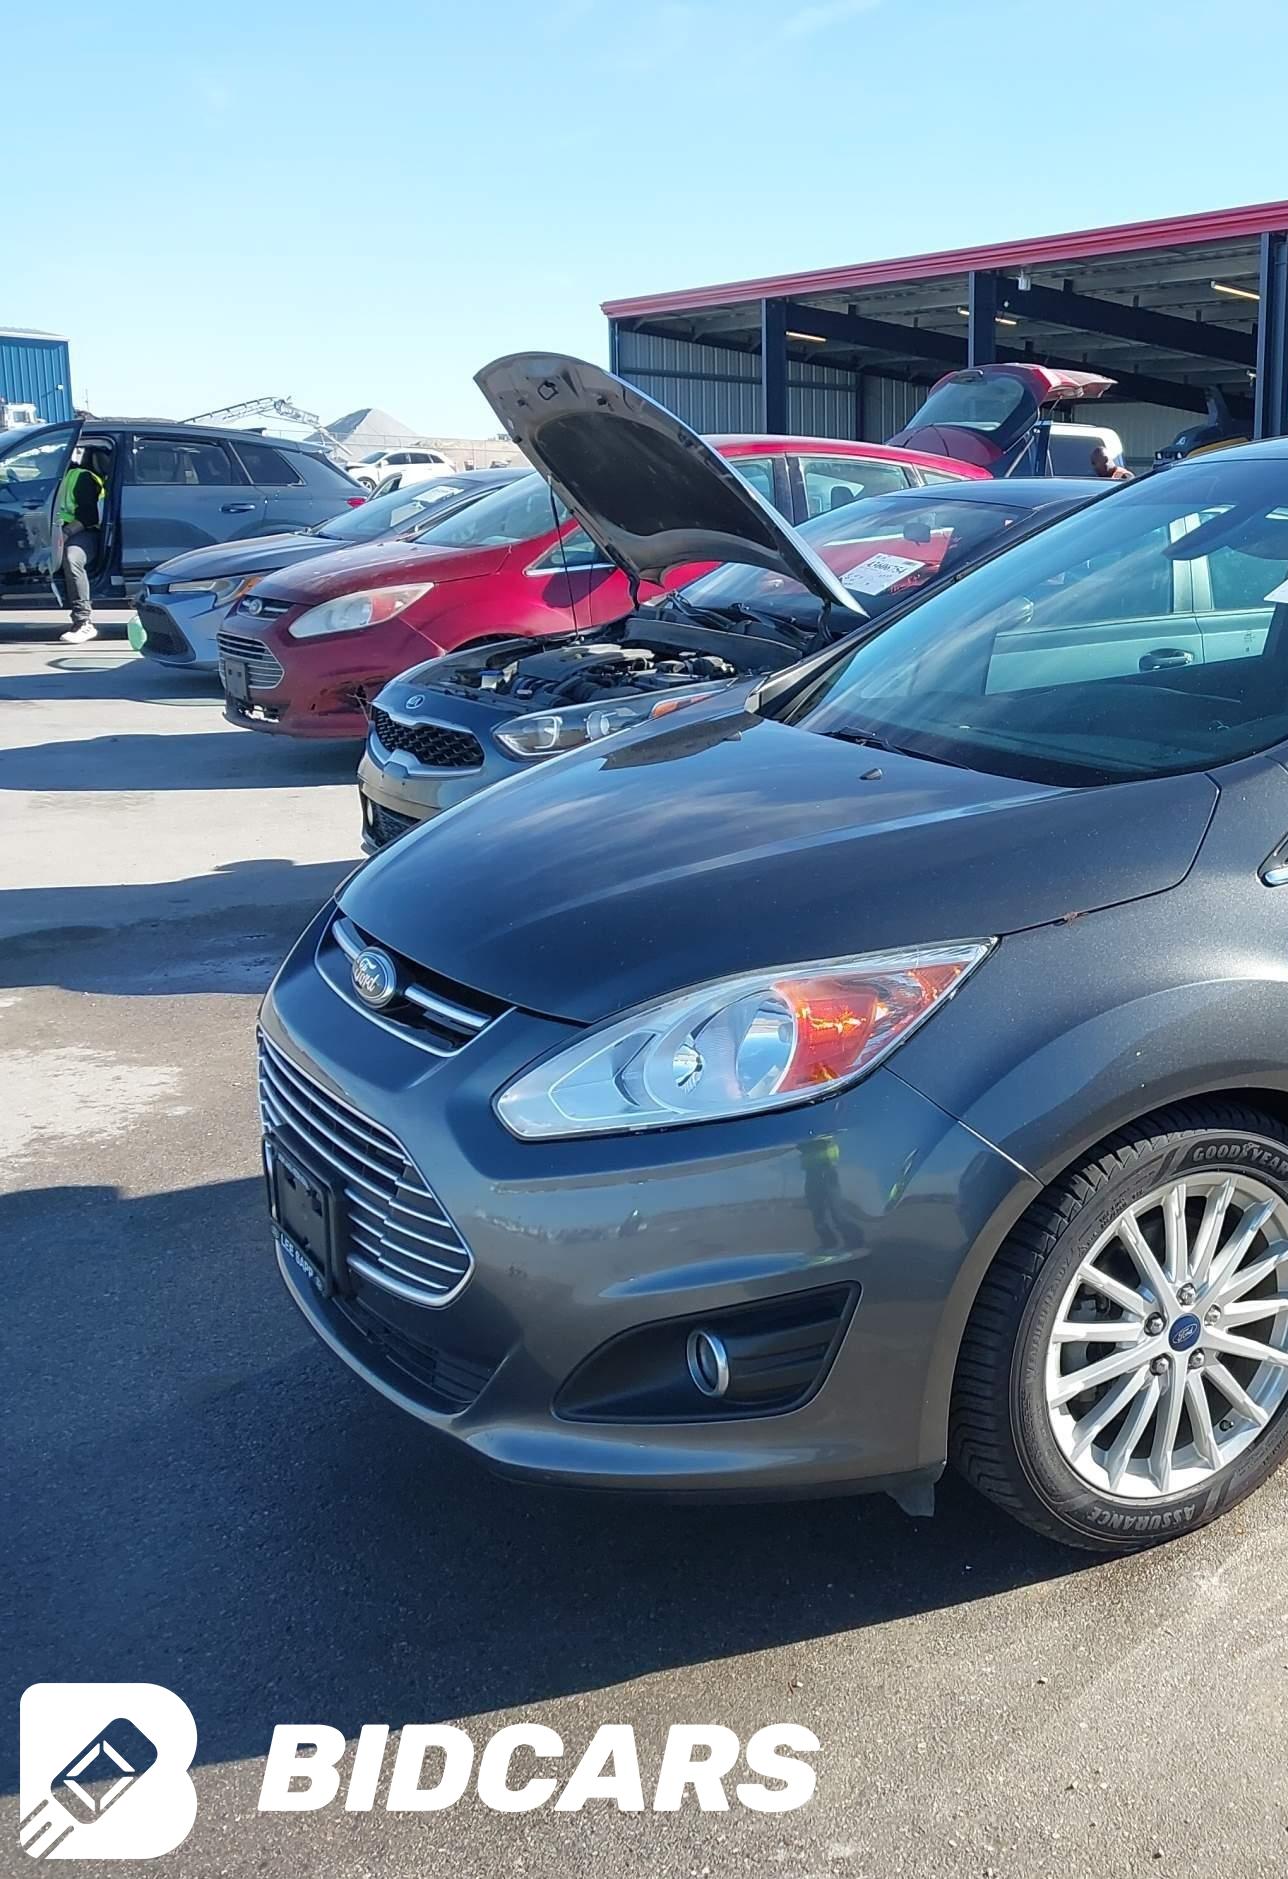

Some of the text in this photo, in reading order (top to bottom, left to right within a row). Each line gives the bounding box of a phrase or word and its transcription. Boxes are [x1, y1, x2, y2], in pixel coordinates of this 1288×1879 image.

[280, 1233, 314, 1279] LEE SAPP
[1087, 1503, 1196, 1531] ASSURANCE
